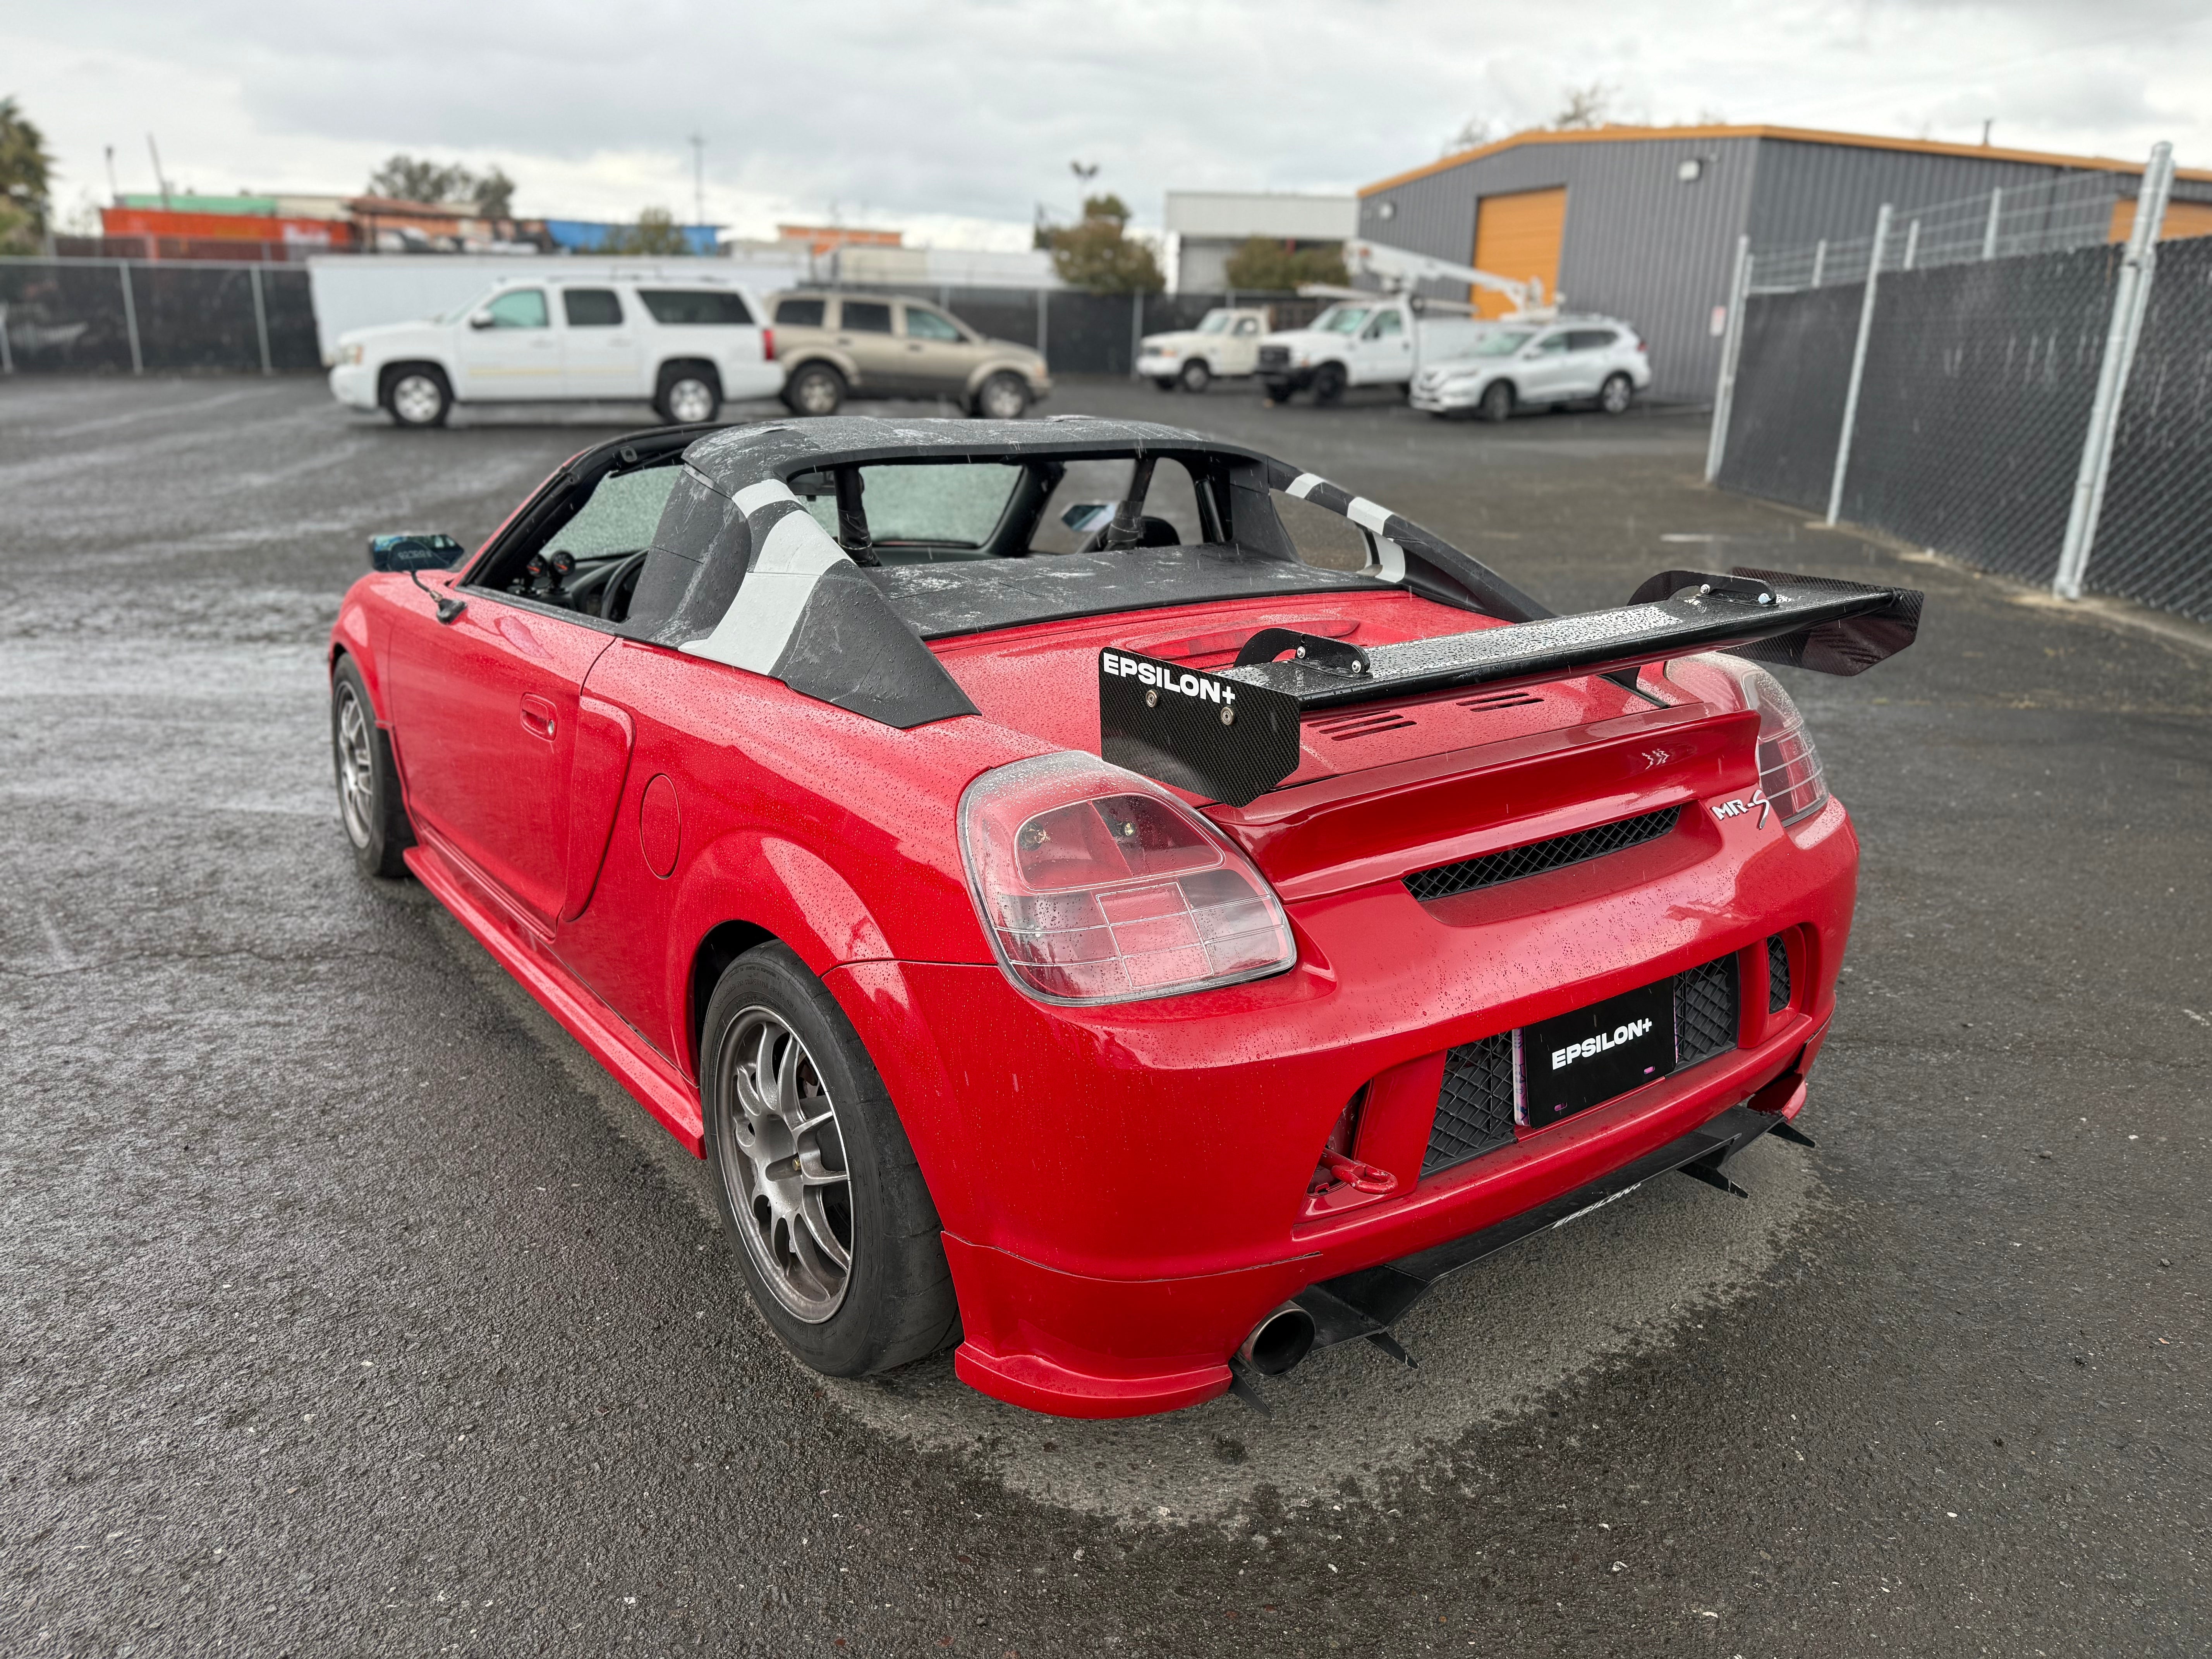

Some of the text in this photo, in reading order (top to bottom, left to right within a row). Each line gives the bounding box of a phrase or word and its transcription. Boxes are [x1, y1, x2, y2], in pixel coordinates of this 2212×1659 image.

[1103, 653, 1235, 705] EPSILON+
[1711, 789, 1770, 830] MR-S
[1552, 1017, 1652, 1070] EPSILON+
